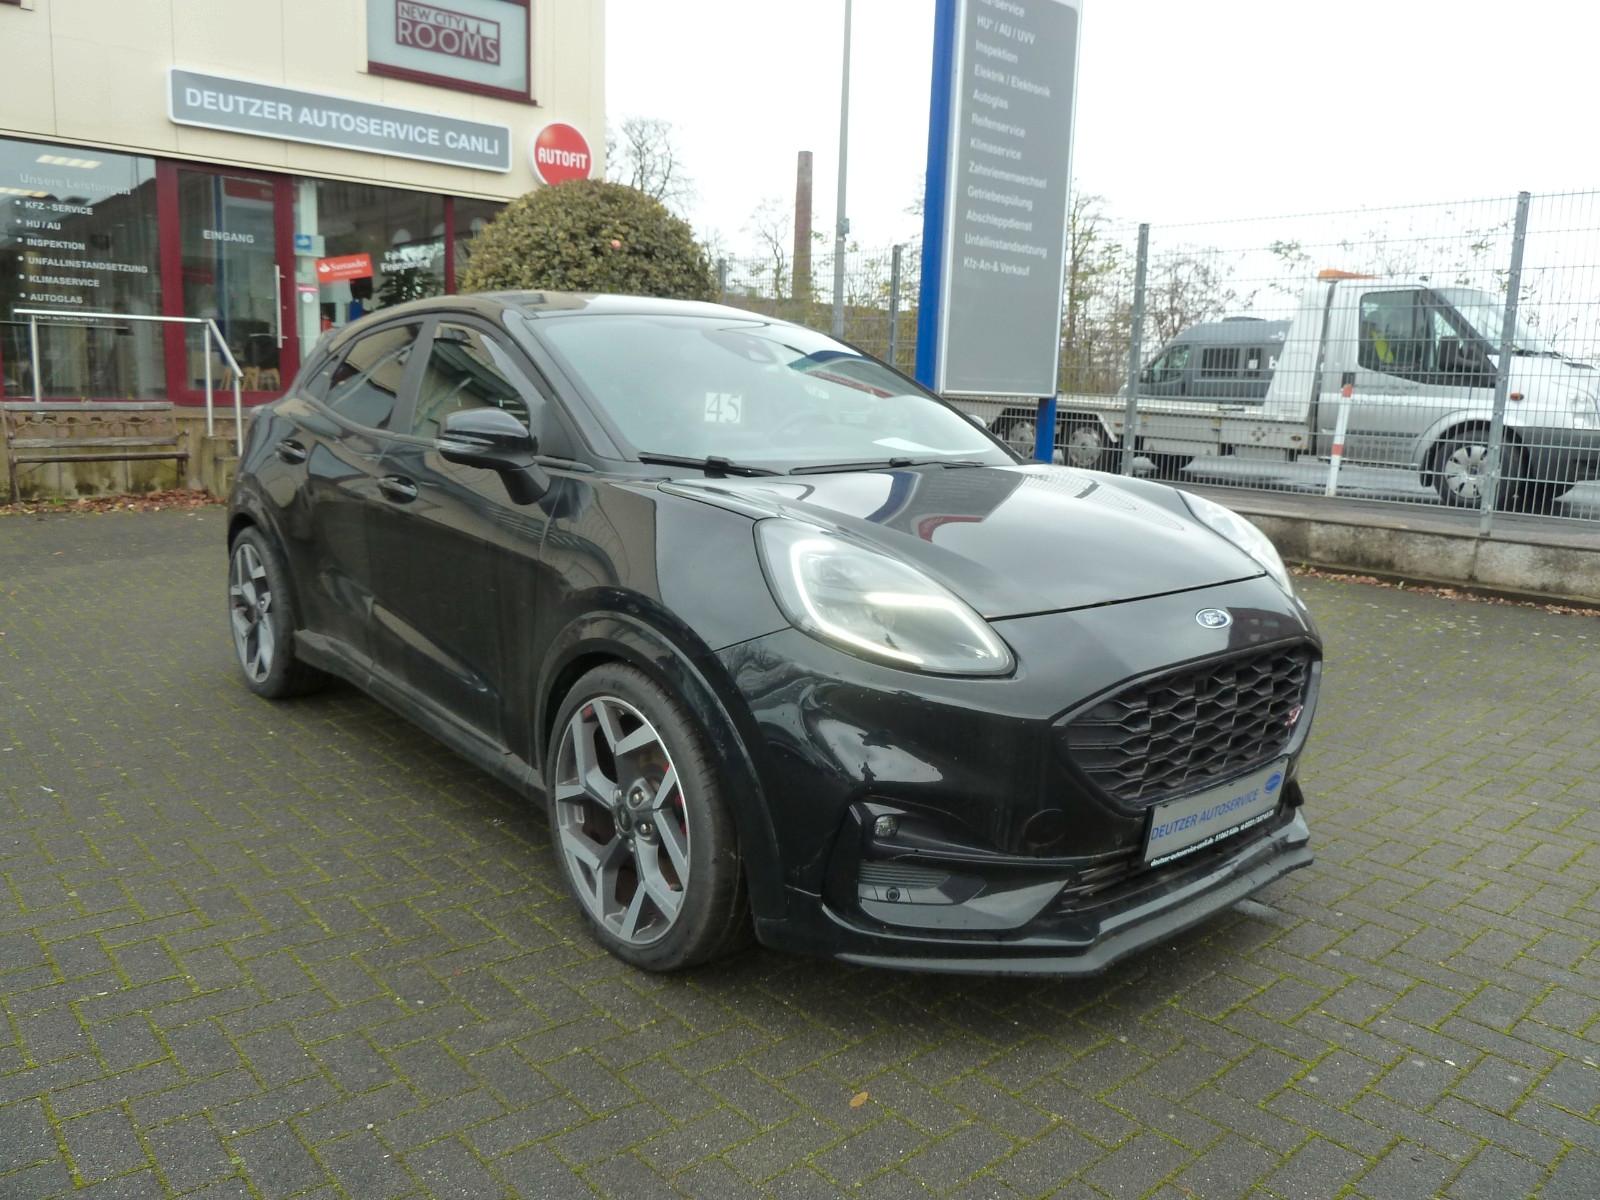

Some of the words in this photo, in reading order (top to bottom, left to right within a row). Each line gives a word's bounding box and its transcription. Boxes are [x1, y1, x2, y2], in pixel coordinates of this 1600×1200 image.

[400, 5, 431, 21] NEW
[434, 12, 464, 30] CITY
[1000, 23, 1011, 37] AU
[398, 20, 499, 62] ROOMS
[976, 40, 1018, 64] Inspektion
[1011, 75, 1050, 97] Elektronik
[973, 89, 1008, 109] Autoglas
[185, 87, 292, 122] DEUTZER
[298, 107, 440, 146] AUTOSERVICE
[444, 131, 499, 155] CANLI
[972, 113, 1026, 138] Reifenservice
[538, 147, 588, 170] AUTOFIT
[970, 137, 1022, 160] Klimaservice
[20, 173, 62, 187] Unsere
[25, 201, 45, 210] KFZ
[51, 204, 94, 215] SERVICE
[26, 220, 40, 229] HU
[47, 221, 61, 231] AU
[966, 210, 1032, 231] Abschleppdienst
[27, 238, 86, 251] INSPEKTION
[203, 229, 255, 244] EINGANG
[28, 256, 148, 274] UNFALLINSTANDSETZUNG
[29, 275, 100, 288] KLIMASERVICE
[30, 293, 83, 304] AUTOGLAS
[706, 393, 741, 422] 45
[1151, 814, 1198, 841] DEUTZER
[1200, 788, 1260, 823] AUTOSERVICE
